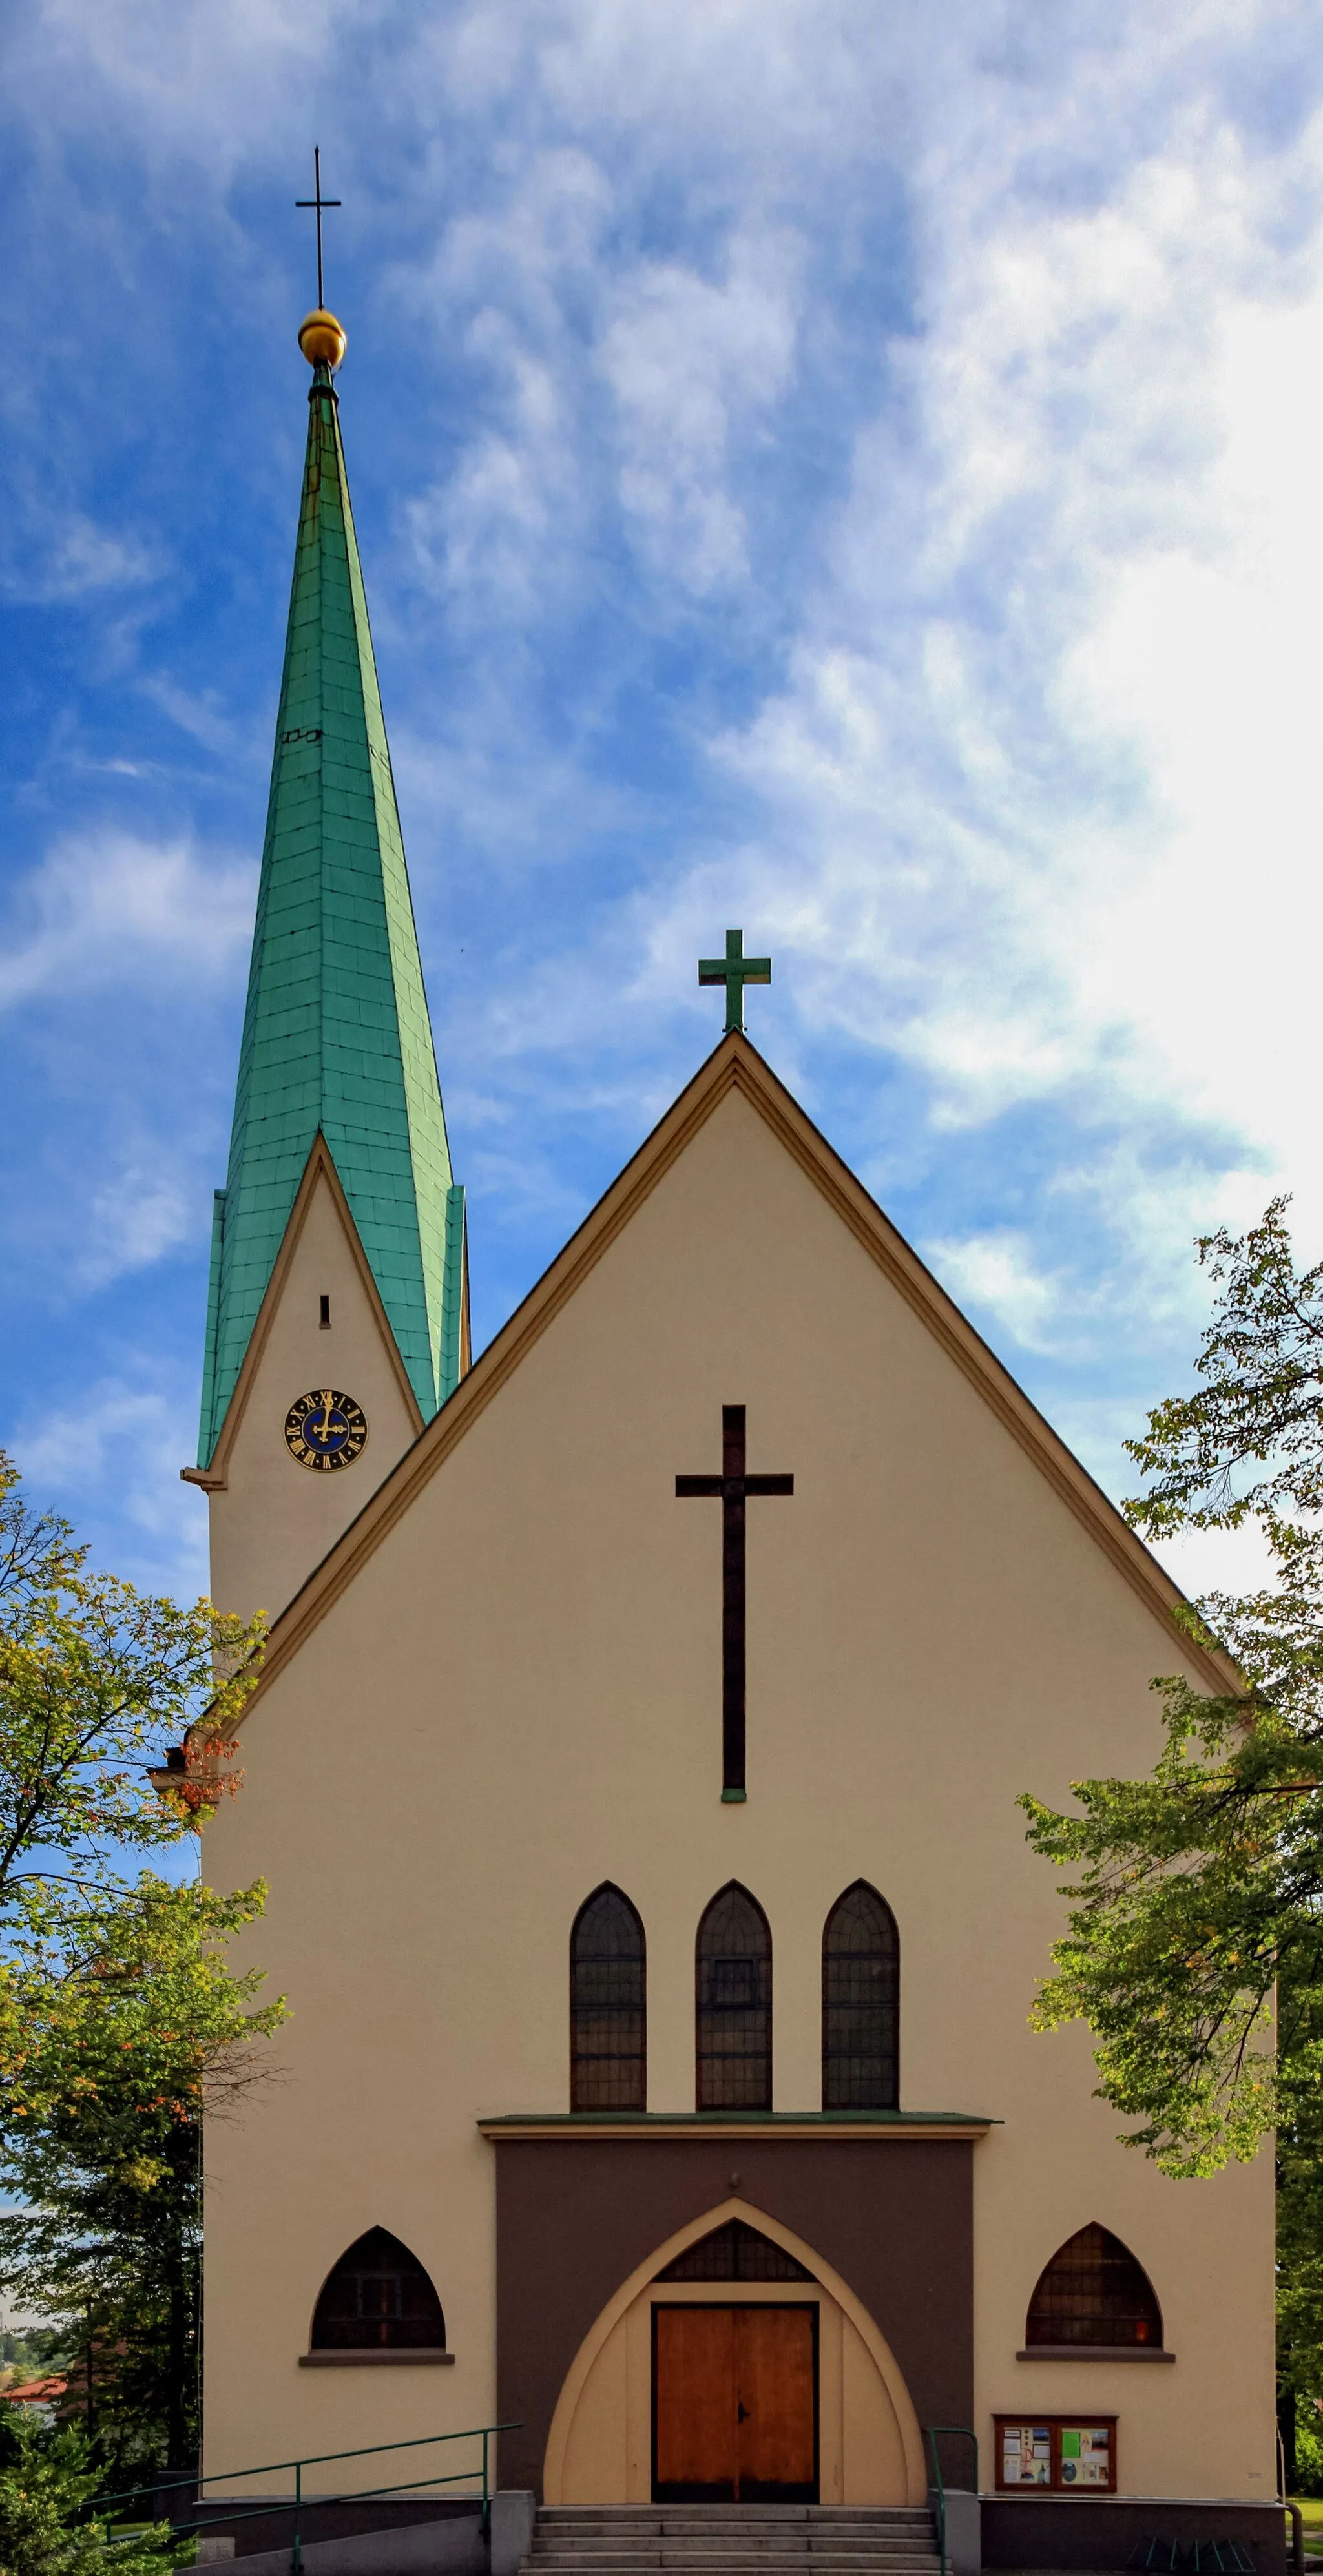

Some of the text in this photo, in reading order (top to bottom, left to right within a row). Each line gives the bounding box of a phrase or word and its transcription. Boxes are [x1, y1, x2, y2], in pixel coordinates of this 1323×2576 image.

[303, 1395, 317, 1411] XI
[338, 1396, 346, 1409] I
[290, 1409, 305, 1421] X
[347, 1409, 360, 1419] II
[286, 1426, 300, 1435] IX
[289, 1439, 306, 1455] VIII
[348, 1440, 362, 1453] IV
[303, 1451, 316, 1466] VII
[322, 1455, 331, 1468] VI
[338, 1451, 348, 1464] V
